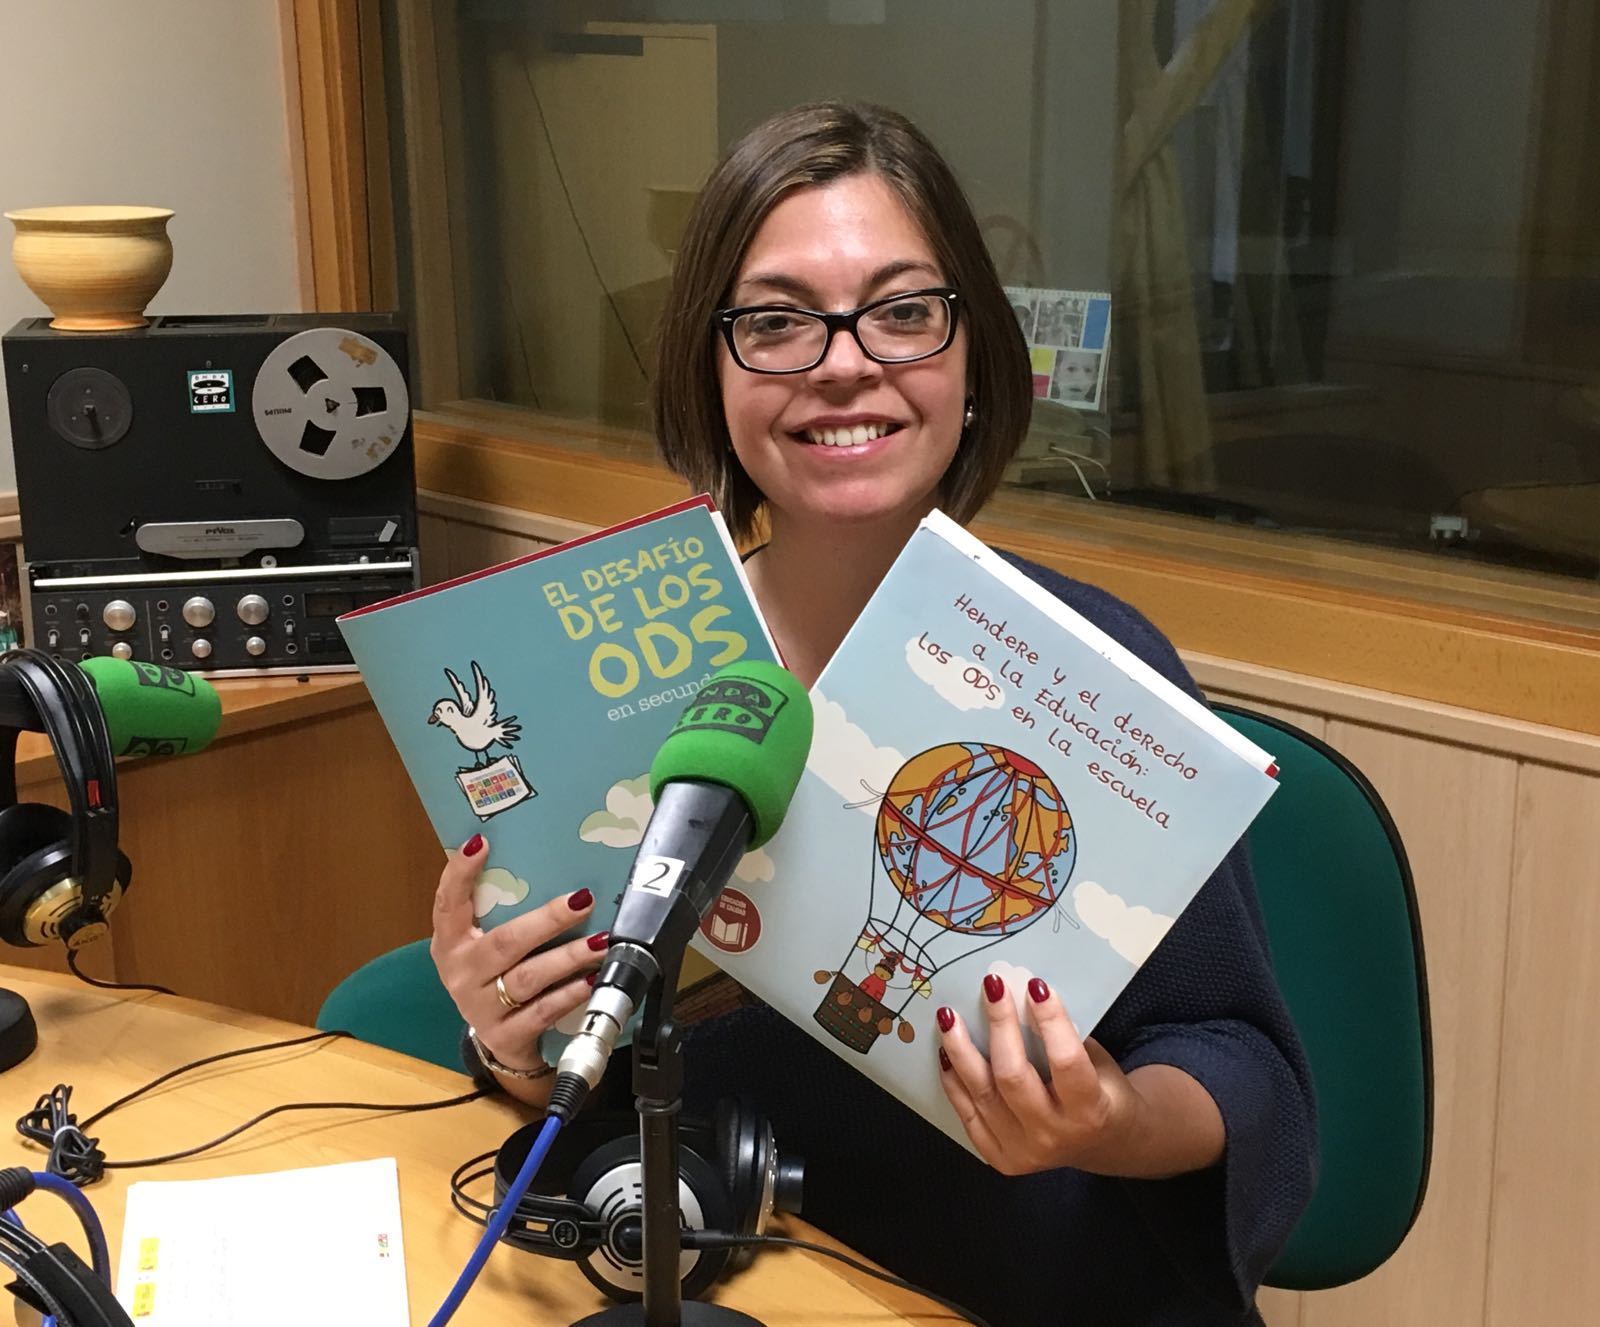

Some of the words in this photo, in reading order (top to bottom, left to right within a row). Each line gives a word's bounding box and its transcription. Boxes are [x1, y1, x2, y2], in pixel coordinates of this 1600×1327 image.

[193, 395, 227, 404] CERO
[542, 581, 579, 607] EL
[581, 536, 704, 592] DESAFÍO
[558, 593, 623, 640] DE
[632, 562, 723, 620] LOS
[589, 604, 748, 698] ODS
[607, 704, 636, 721] en
[678, 707, 752, 726] ERO
[972, 643, 986, 661] a
[1035, 688, 1149, 777] Educación:
[1053, 667, 1067, 685] y
[1078, 690, 1101, 712] el
[963, 667, 1001, 701] ODS
[1011, 705, 1036, 730] en
[1087, 761, 1169, 829] escuela
[641, 861, 671, 891] 2
